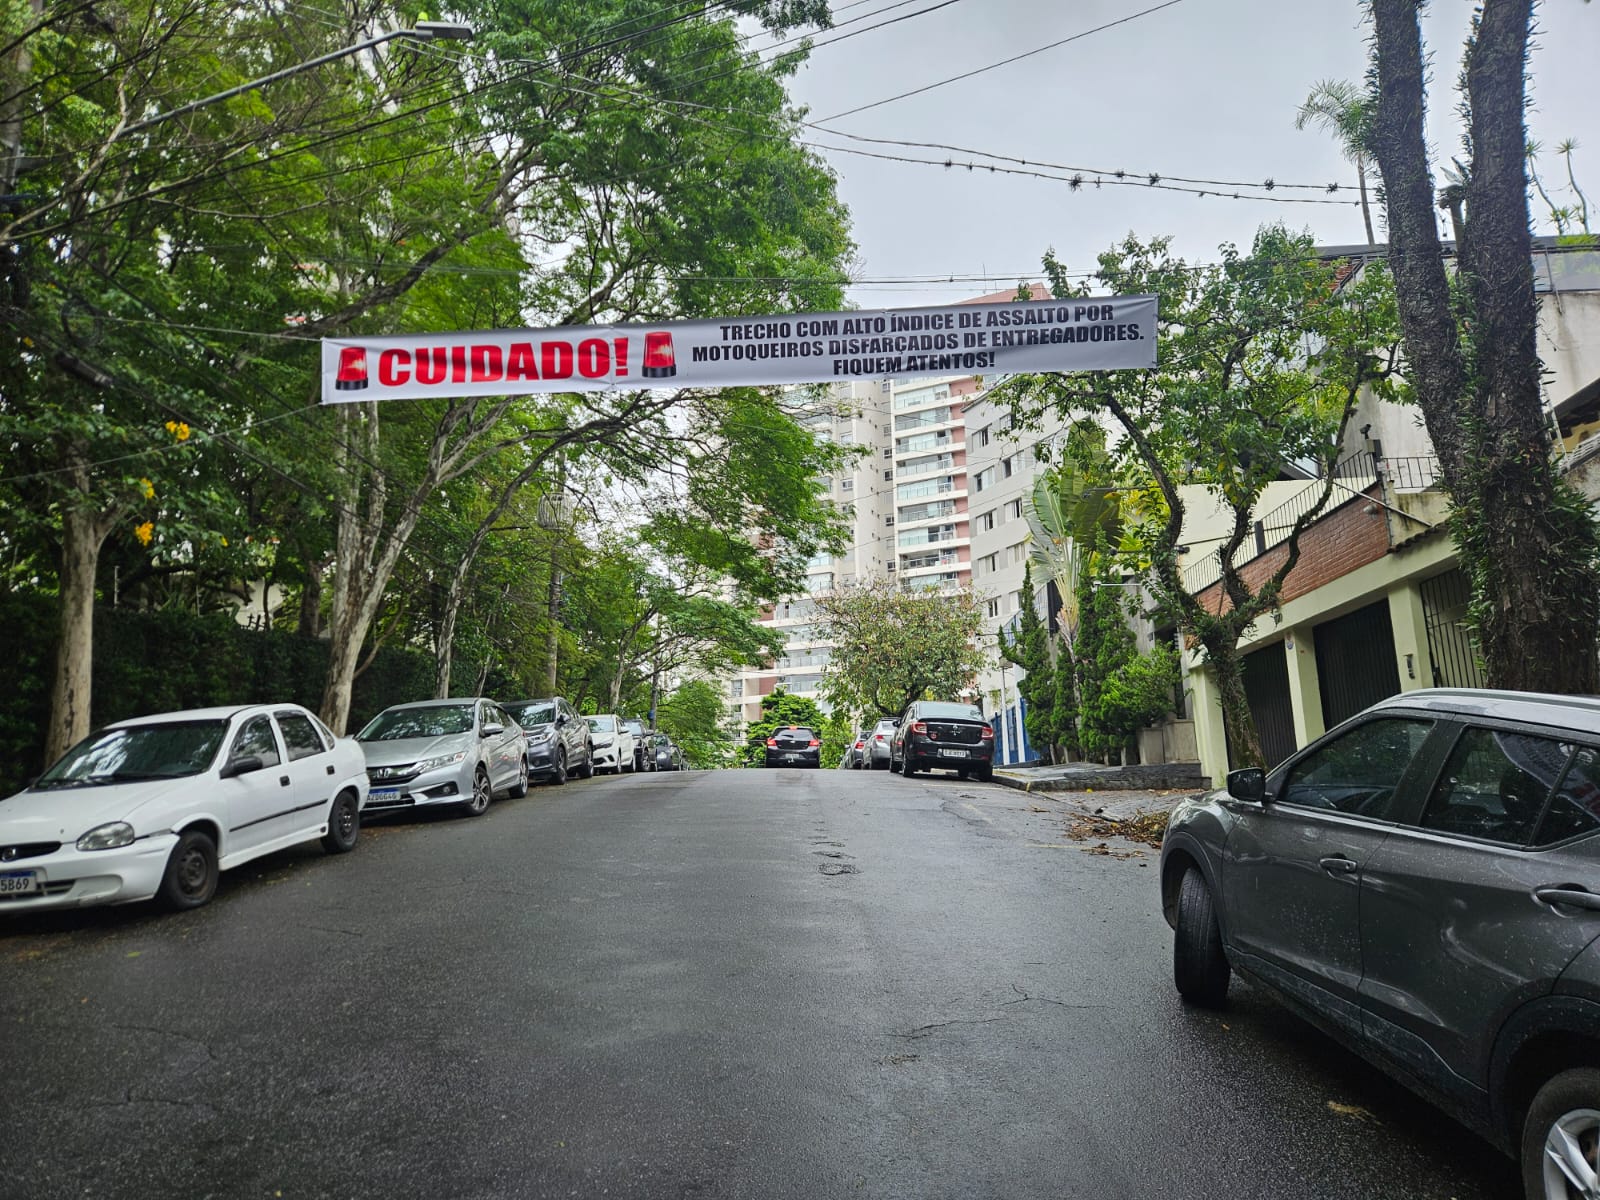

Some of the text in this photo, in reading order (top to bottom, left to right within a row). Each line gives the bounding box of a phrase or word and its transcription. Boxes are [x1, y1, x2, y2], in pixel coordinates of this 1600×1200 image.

[720, 304, 1114, 341] TRECHO COM ALTO ÍNDICE DE ASSALTO POR
[692, 323, 1145, 362] MOTOQUEIROS DISFARÇADOS DE ENTREGADORES.
[378, 336, 630, 388] CUIDADO!
[833, 351, 995, 376] FIQUEM ATENTOS!
